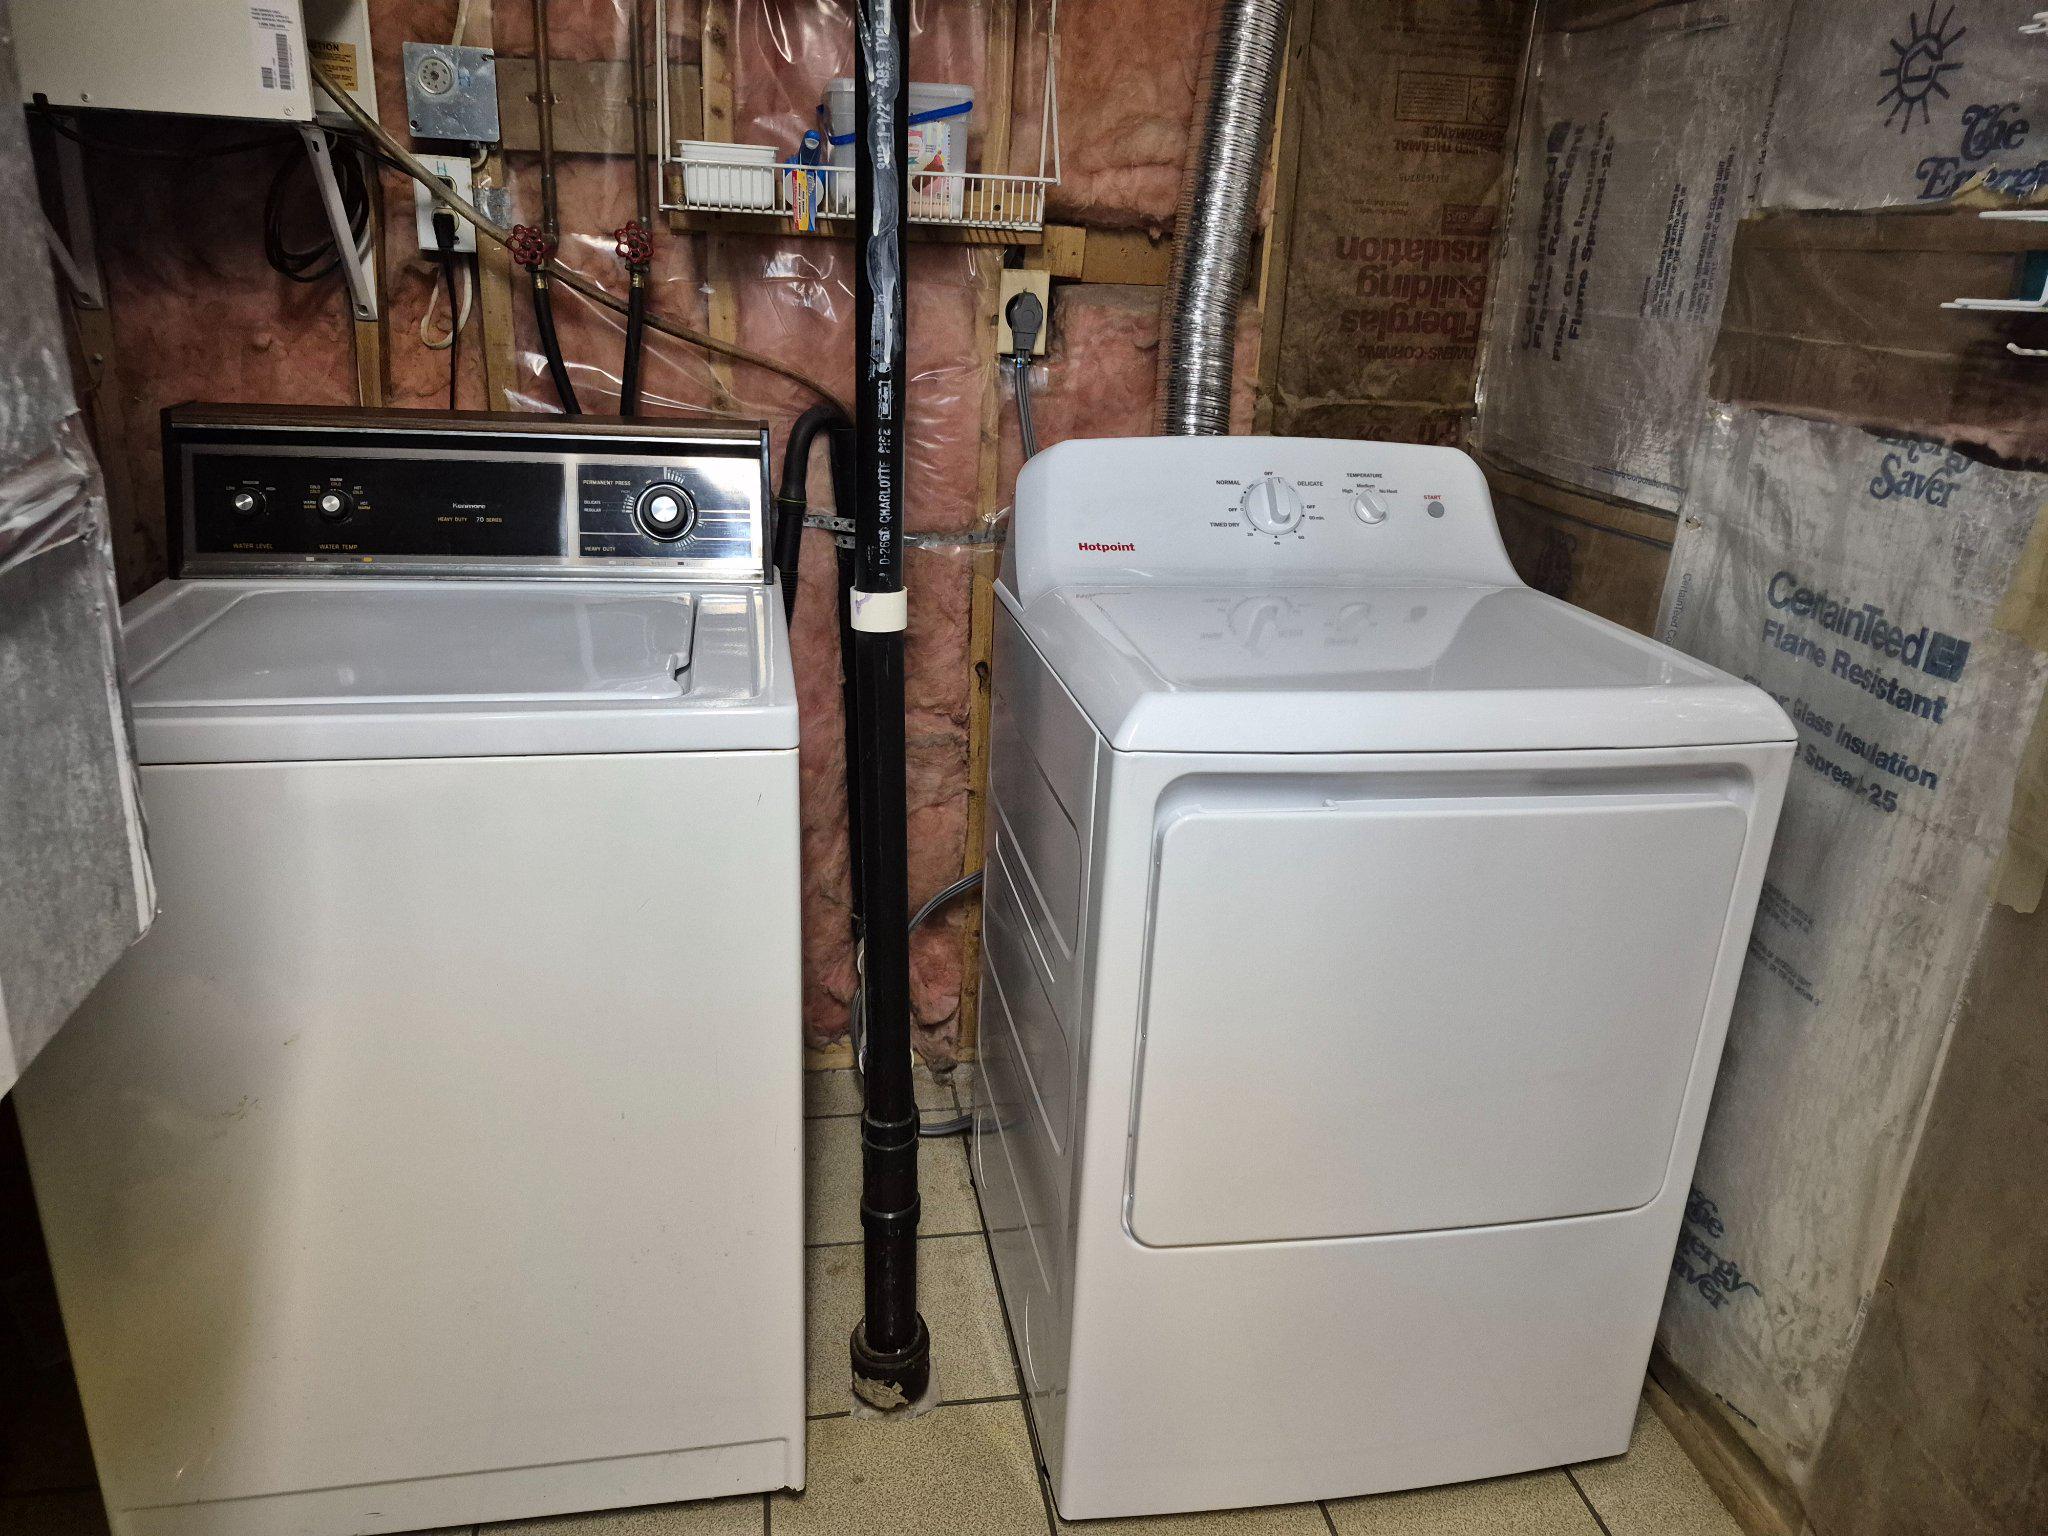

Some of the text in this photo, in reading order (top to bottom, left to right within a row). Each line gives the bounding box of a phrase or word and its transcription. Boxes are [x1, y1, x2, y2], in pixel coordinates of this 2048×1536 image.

[875, 60, 890, 87] ABS
[1961, 102, 2030, 160] The
[437, 161, 447, 176] H
[1335, 236, 1490, 275] Insulation
[1356, 264, 1487, 309] Building
[1532, 265, 1554, 348] Flame
[1552, 303, 1569, 361] Fiber
[1563, 234, 1580, 297] Glass
[1568, 268, 1589, 340] Flame
[1341, 302, 1482, 343] Fiberglas
[583, 479, 613, 487] PERMANENT
[877, 460, 892, 524] CHARLOTTE
[1870, 453, 1961, 508] Saver
[1078, 542, 1136, 553] Hotpoint
[1670, 573, 1691, 629] CertainTeed
[1767, 570, 1930, 669] CertainTeed
[1761, 618, 1827, 668] Flame
[1831, 648, 1949, 725] Resistant
[1793, 697, 1939, 791] Glass Insulation
[1677, 1257, 1730, 1311] aver
[1679, 1239, 1760, 1297] ergy
